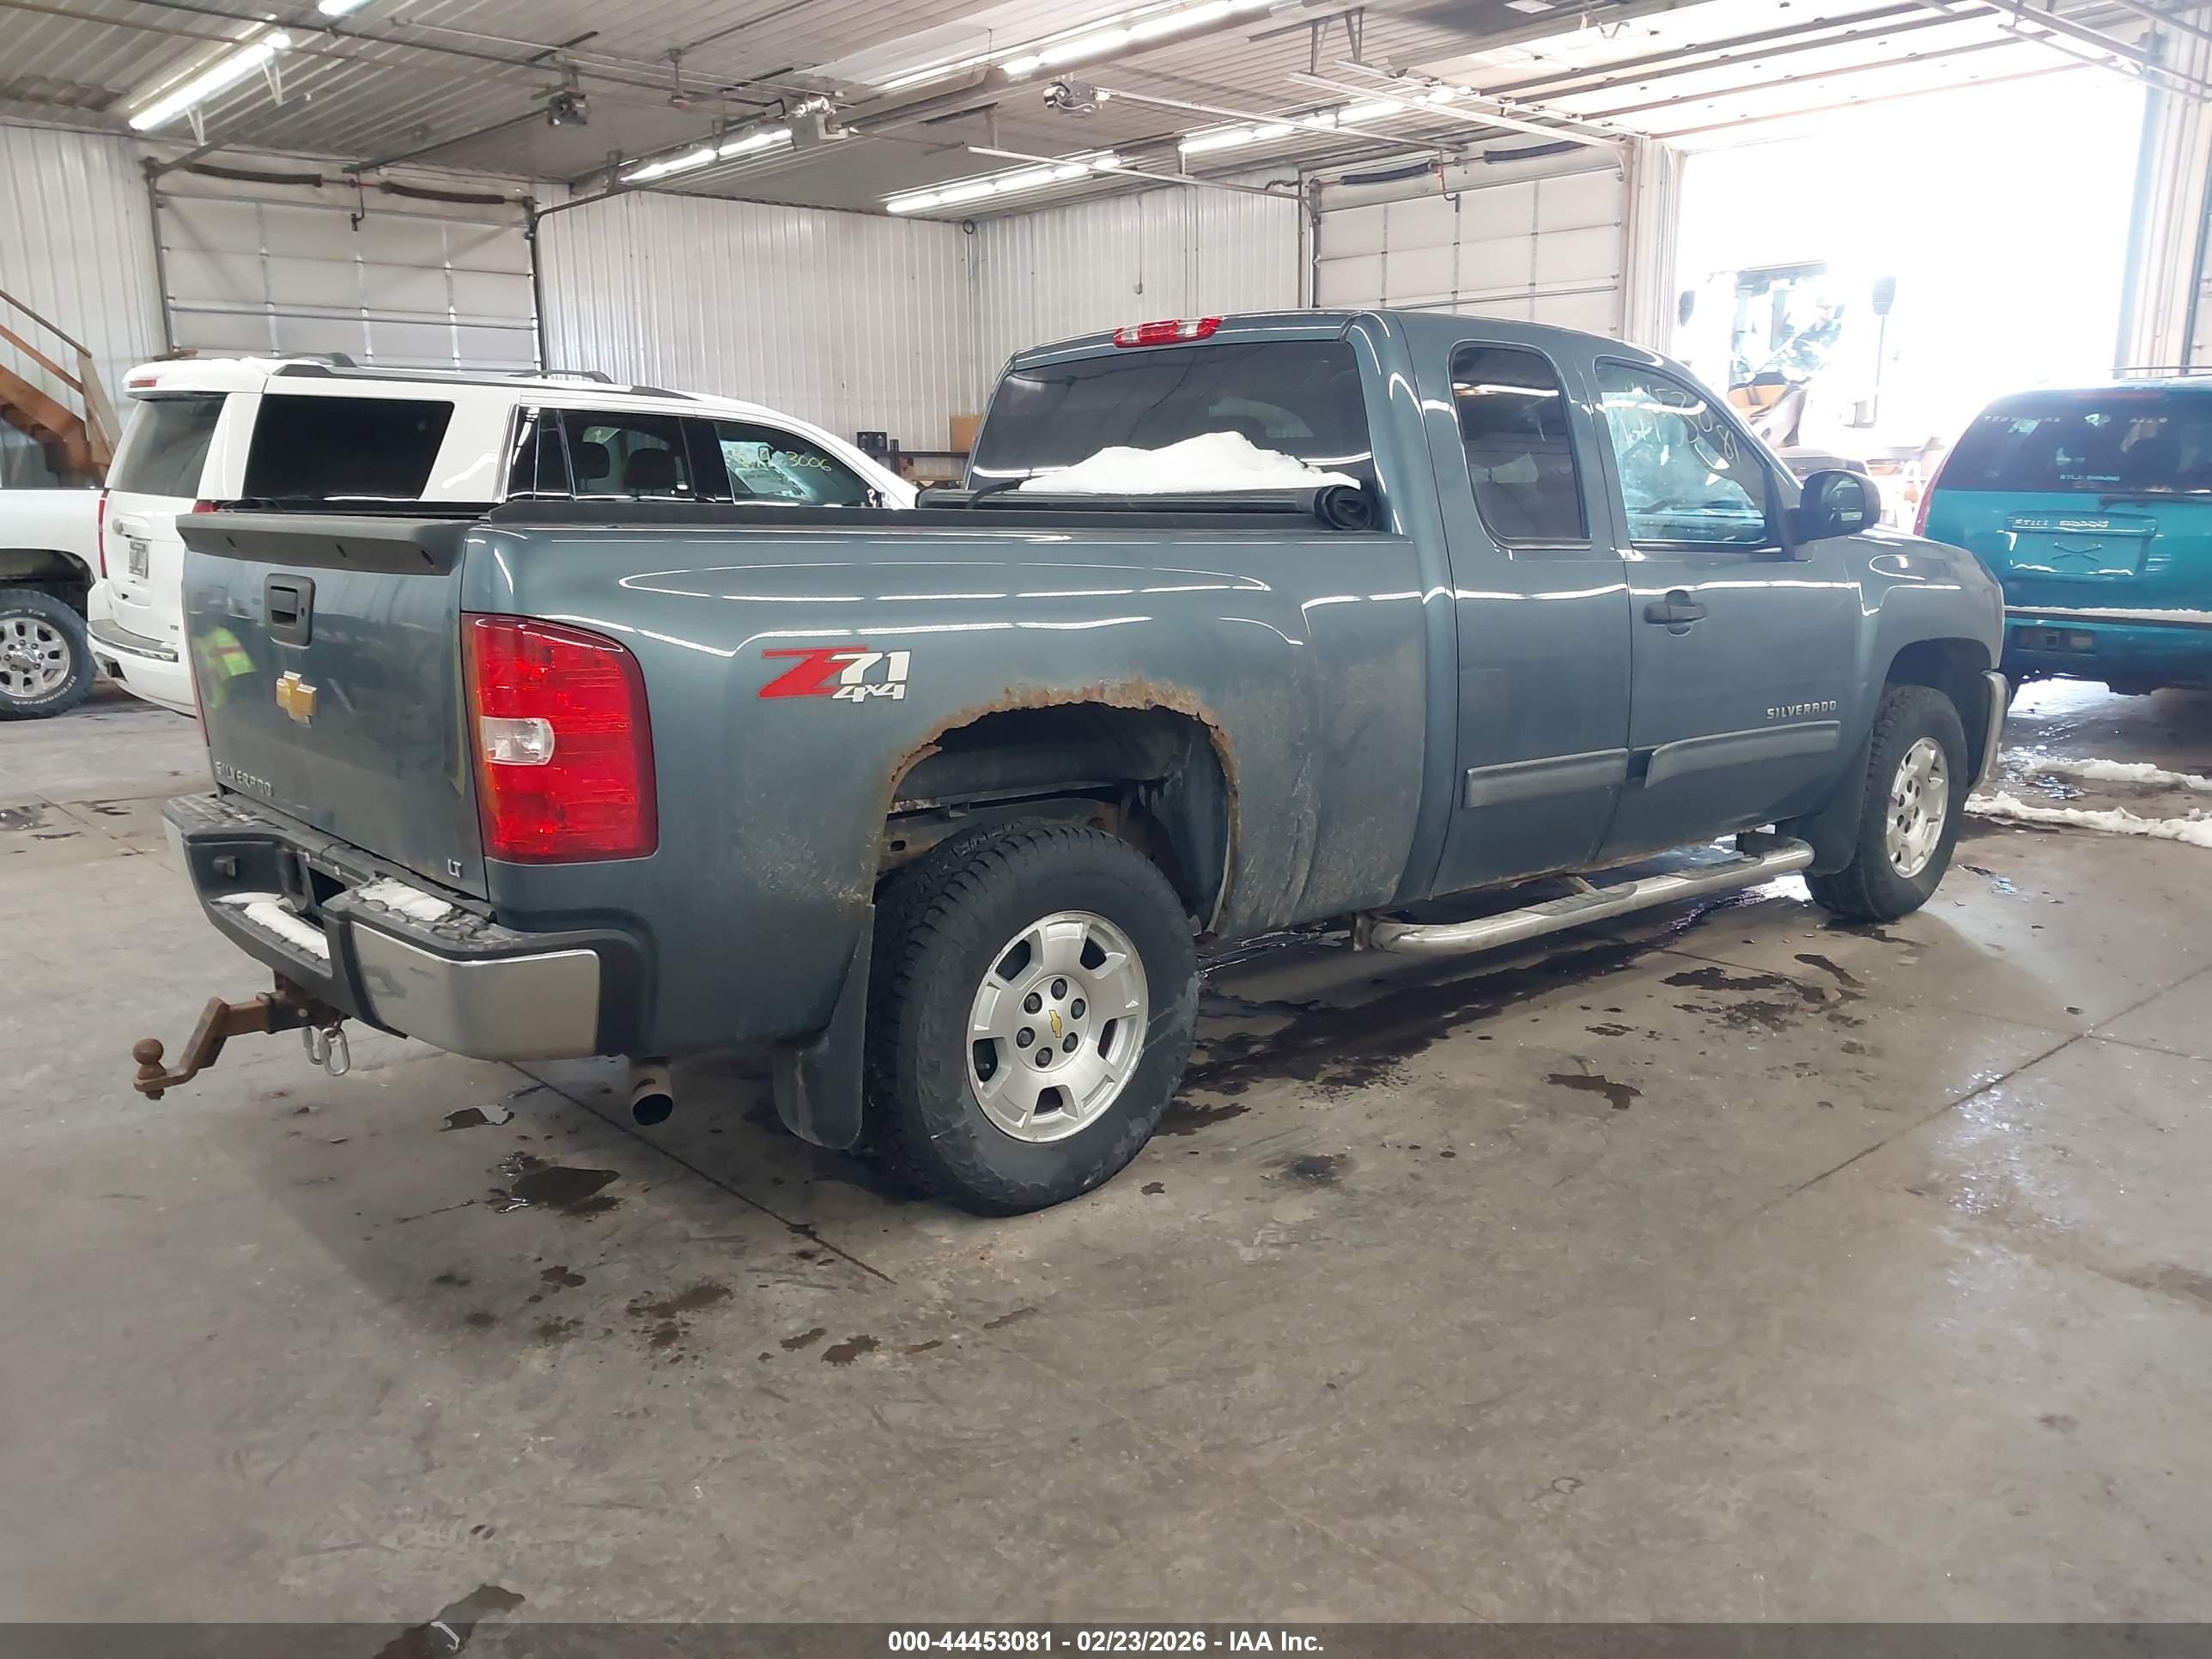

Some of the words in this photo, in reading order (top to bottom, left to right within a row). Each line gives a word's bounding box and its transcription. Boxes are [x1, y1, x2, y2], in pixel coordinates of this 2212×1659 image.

[758, 645, 912, 699] Z71
[1765, 700, 1838, 720] SILVERADO
[447, 858, 462, 878] LT
